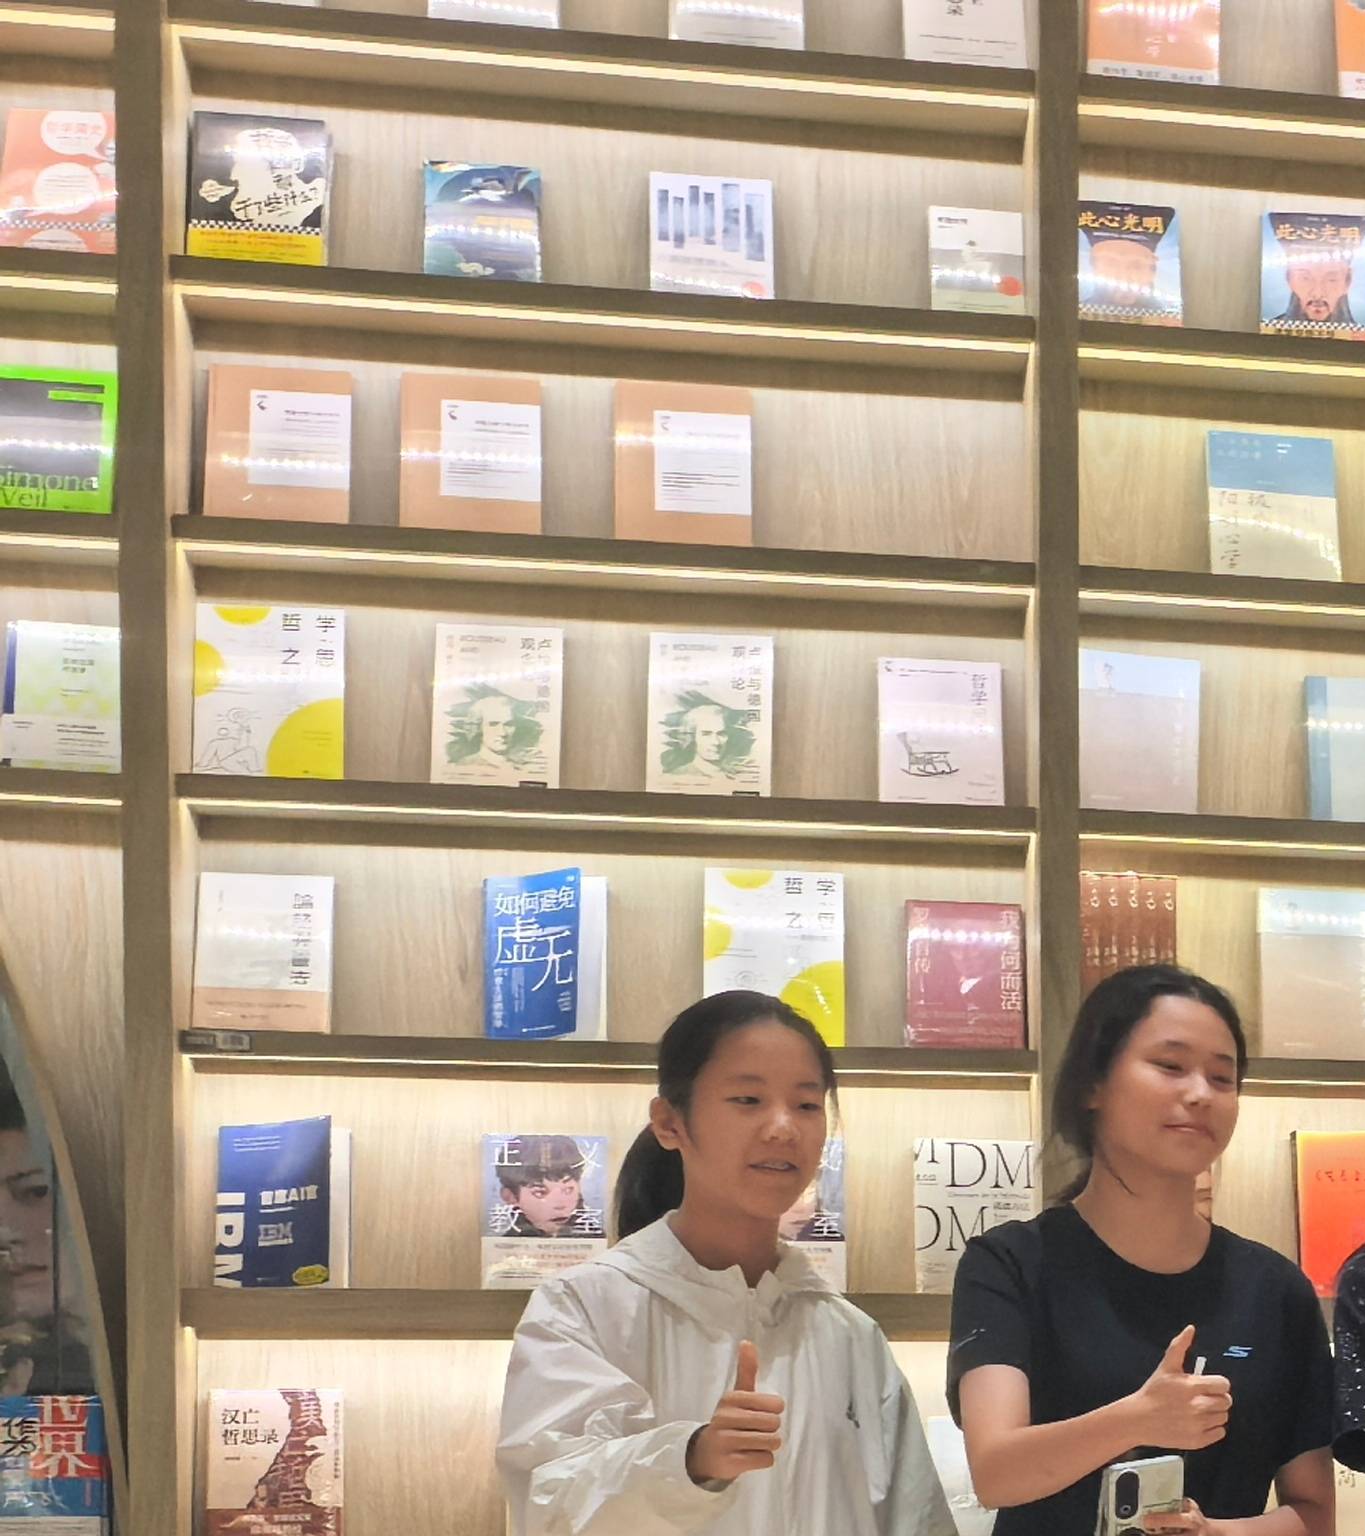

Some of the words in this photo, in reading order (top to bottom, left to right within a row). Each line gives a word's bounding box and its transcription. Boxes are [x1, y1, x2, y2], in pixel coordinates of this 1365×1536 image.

[1078, 211, 1164, 234] 此心光明
[1276, 224, 1361, 245] 此心光明
[945, 1140, 1035, 1189] DM
